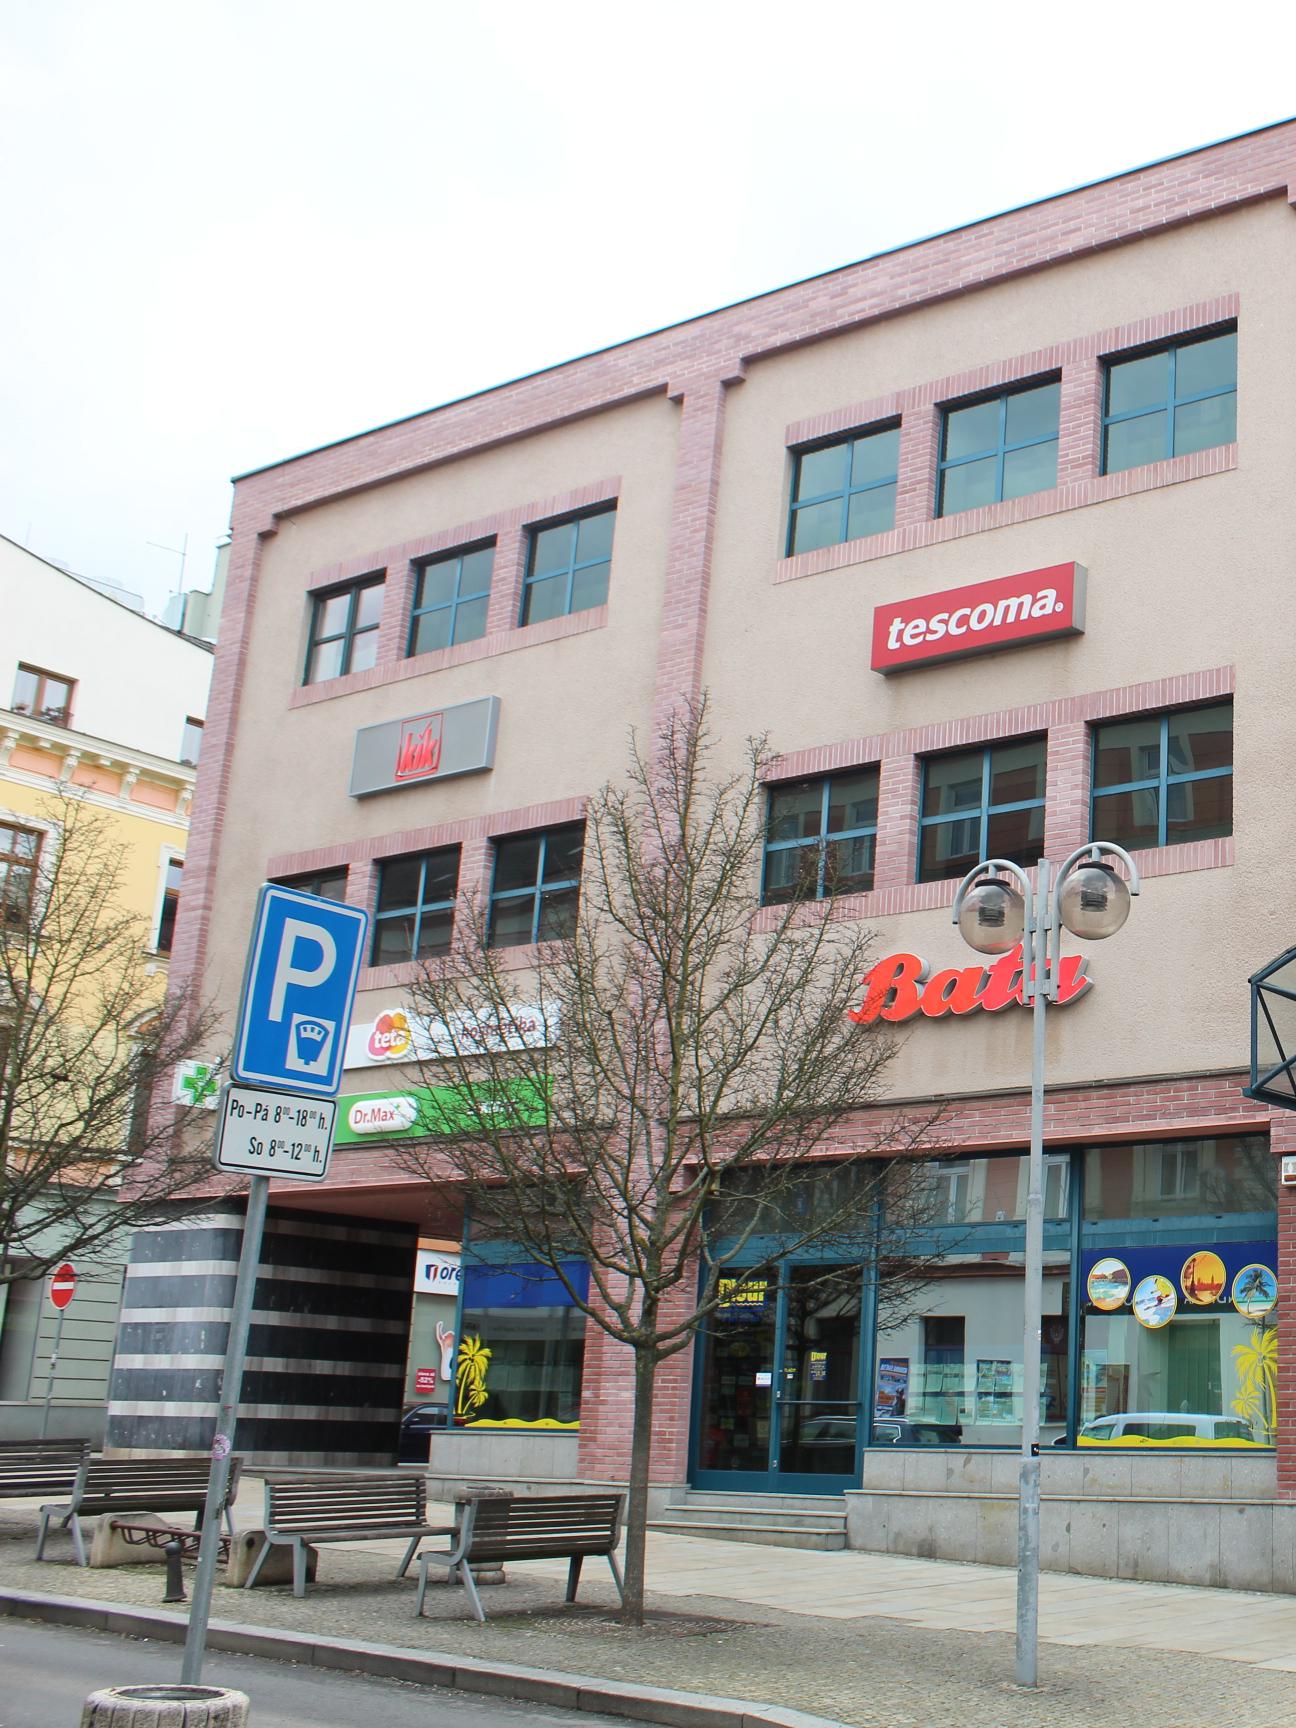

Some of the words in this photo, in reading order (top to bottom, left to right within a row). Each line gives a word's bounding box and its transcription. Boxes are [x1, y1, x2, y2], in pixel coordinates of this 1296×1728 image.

[268, 917, 337, 1023] P
[374, 1029, 408, 1049] teta
[230, 1099, 269, 1122] Po-Pá
[318, 1112, 328, 1131] h.
[354, 1108, 395, 1125] Dr.Max
[248, 1136, 263, 1156] So
[312, 1145, 323, 1164] h.
